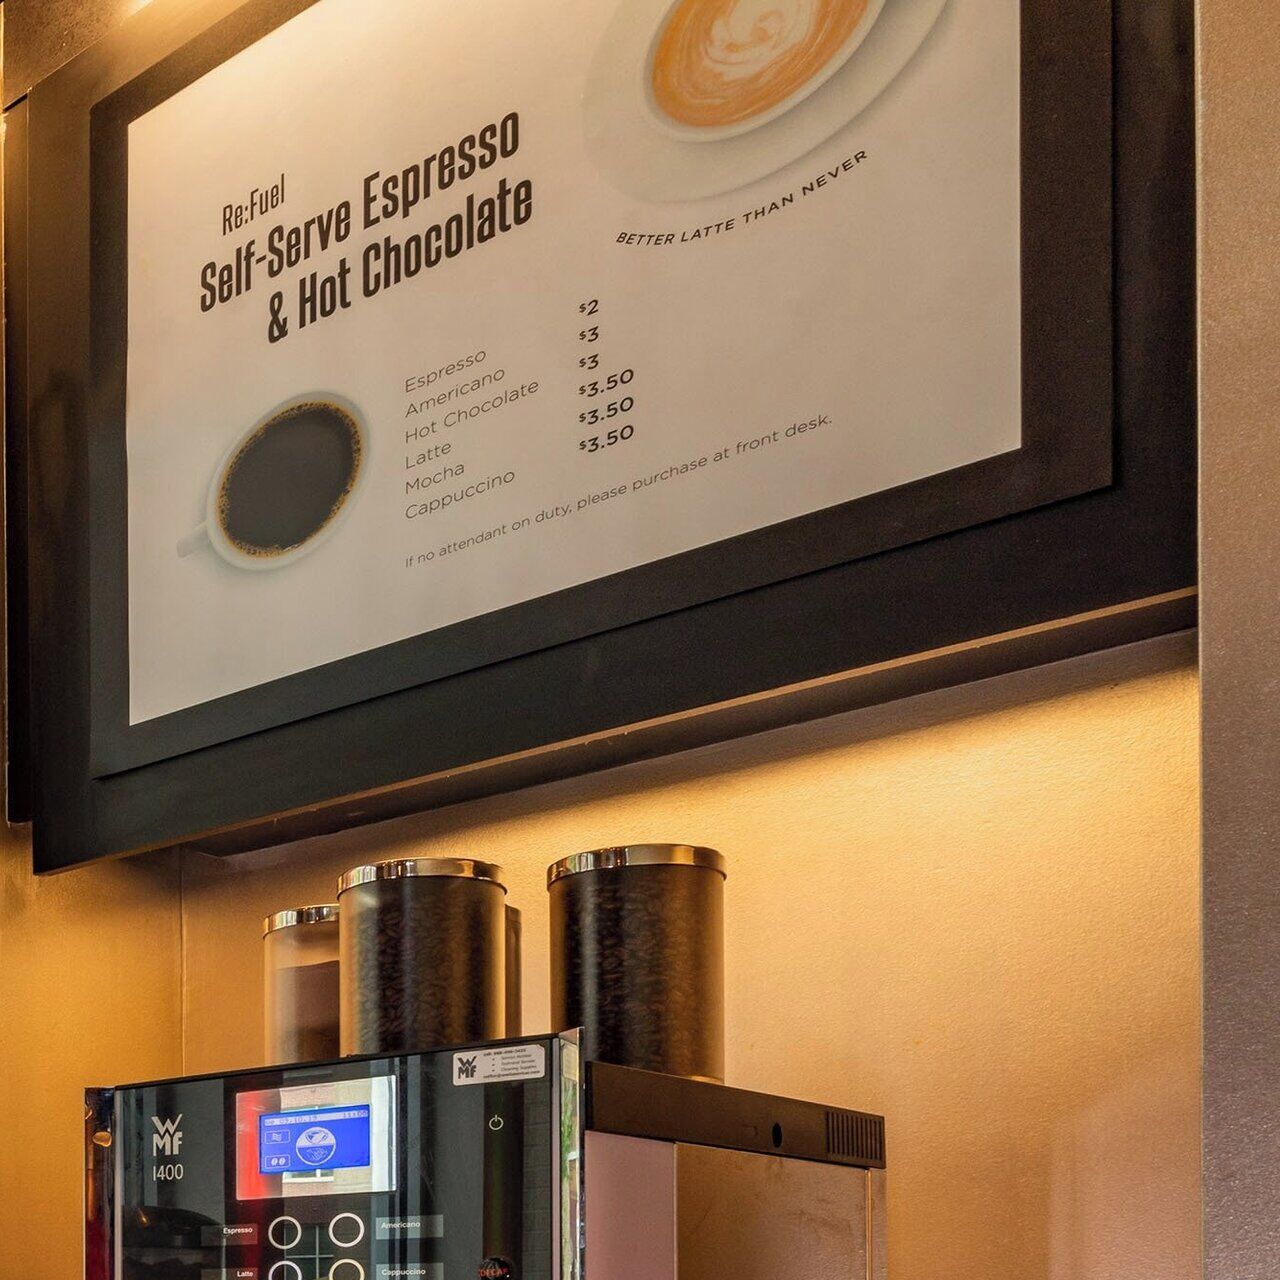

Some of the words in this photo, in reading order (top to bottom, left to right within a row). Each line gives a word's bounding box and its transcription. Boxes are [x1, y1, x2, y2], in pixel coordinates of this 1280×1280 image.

[200, 200, 351, 312] Self-Serve
[363, 111, 519, 230] Espresso
[222, 173, 285, 236] Re:Fuel
[616, 232, 675, 246] BETTER
[681, 218, 736, 243] LATTE
[742, 193, 794, 224] THAN
[801, 151, 868, 196] NEVER
[268, 291, 288, 343] &
[299, 257, 351, 329] Hot
[363, 177, 532, 298] Chocolate
[579, 299, 599, 316] $2
[579, 326, 599, 342] $3
[405, 351, 487, 393] Espresso
[579, 353, 599, 370] $3
[405, 369, 505, 418] Americano
[579, 369, 634, 397] $3.50
[405, 421, 437, 444] Hot
[443, 381, 540, 428] Chocolate
[579, 397, 634, 425] $3.50
[579, 425, 634, 453] $3.50
[405, 442, 452, 469] Latte
[405, 463, 465, 495] Mocha
[405, 555, 414, 569] If
[417, 550, 435, 564] no
[439, 524, 507, 558] attendant
[512, 516, 531, 532] on
[535, 503, 573, 524] duty,
[577, 484, 627, 510] please
[632, 457, 708, 491] purchase
[713, 447, 730, 462] at
[736, 431, 780, 455] front
[785, 413, 833, 438] desk.
[405, 471, 515, 520] Cappuccino
[151, 1113, 183, 1157] WMF
[153, 1163, 184, 1181] 1400
[223, 1226, 253, 1235] Espresso
[381, 1221, 421, 1229] Americano
[381, 1268, 426, 1277] Cappuccino
